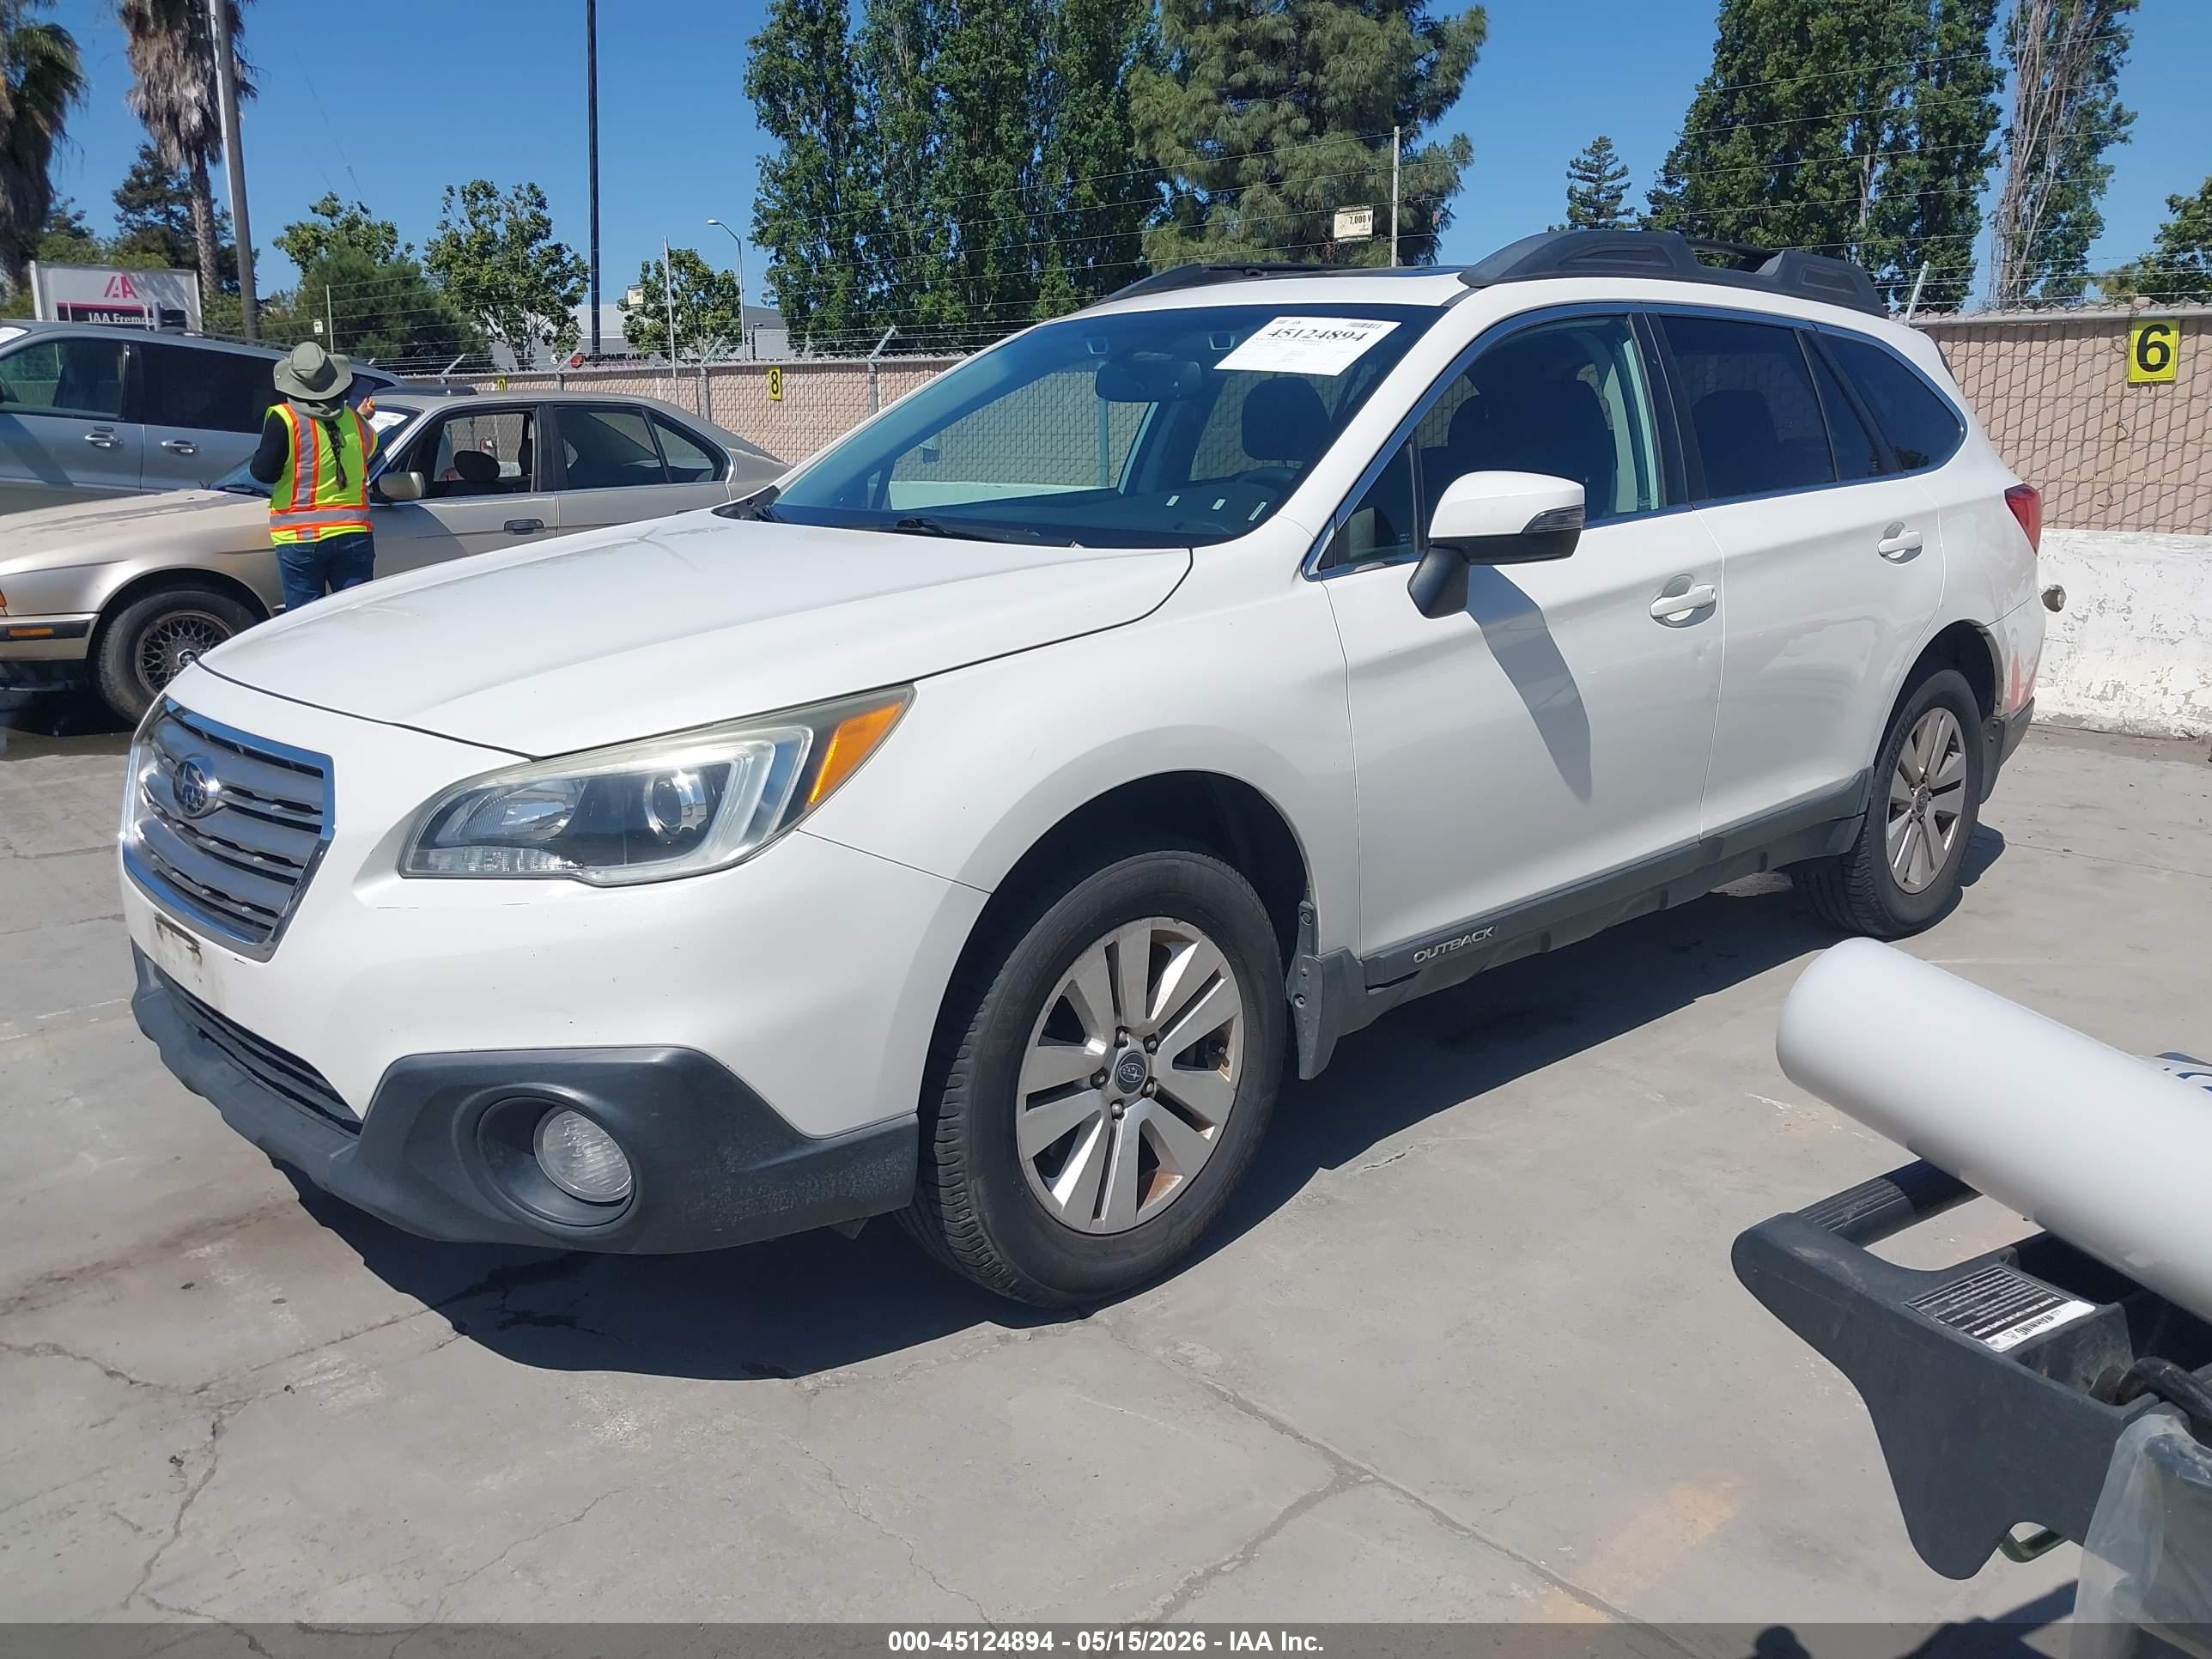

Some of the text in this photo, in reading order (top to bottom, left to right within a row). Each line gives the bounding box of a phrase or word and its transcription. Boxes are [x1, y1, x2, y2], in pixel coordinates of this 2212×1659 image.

[88, 312, 156, 324] IAA Fremon
[1267, 328, 1370, 342] 45124894
[2136, 324, 2171, 372] 6
[771, 370, 779, 395] 8
[1413, 926, 1496, 963] OUTBACK
